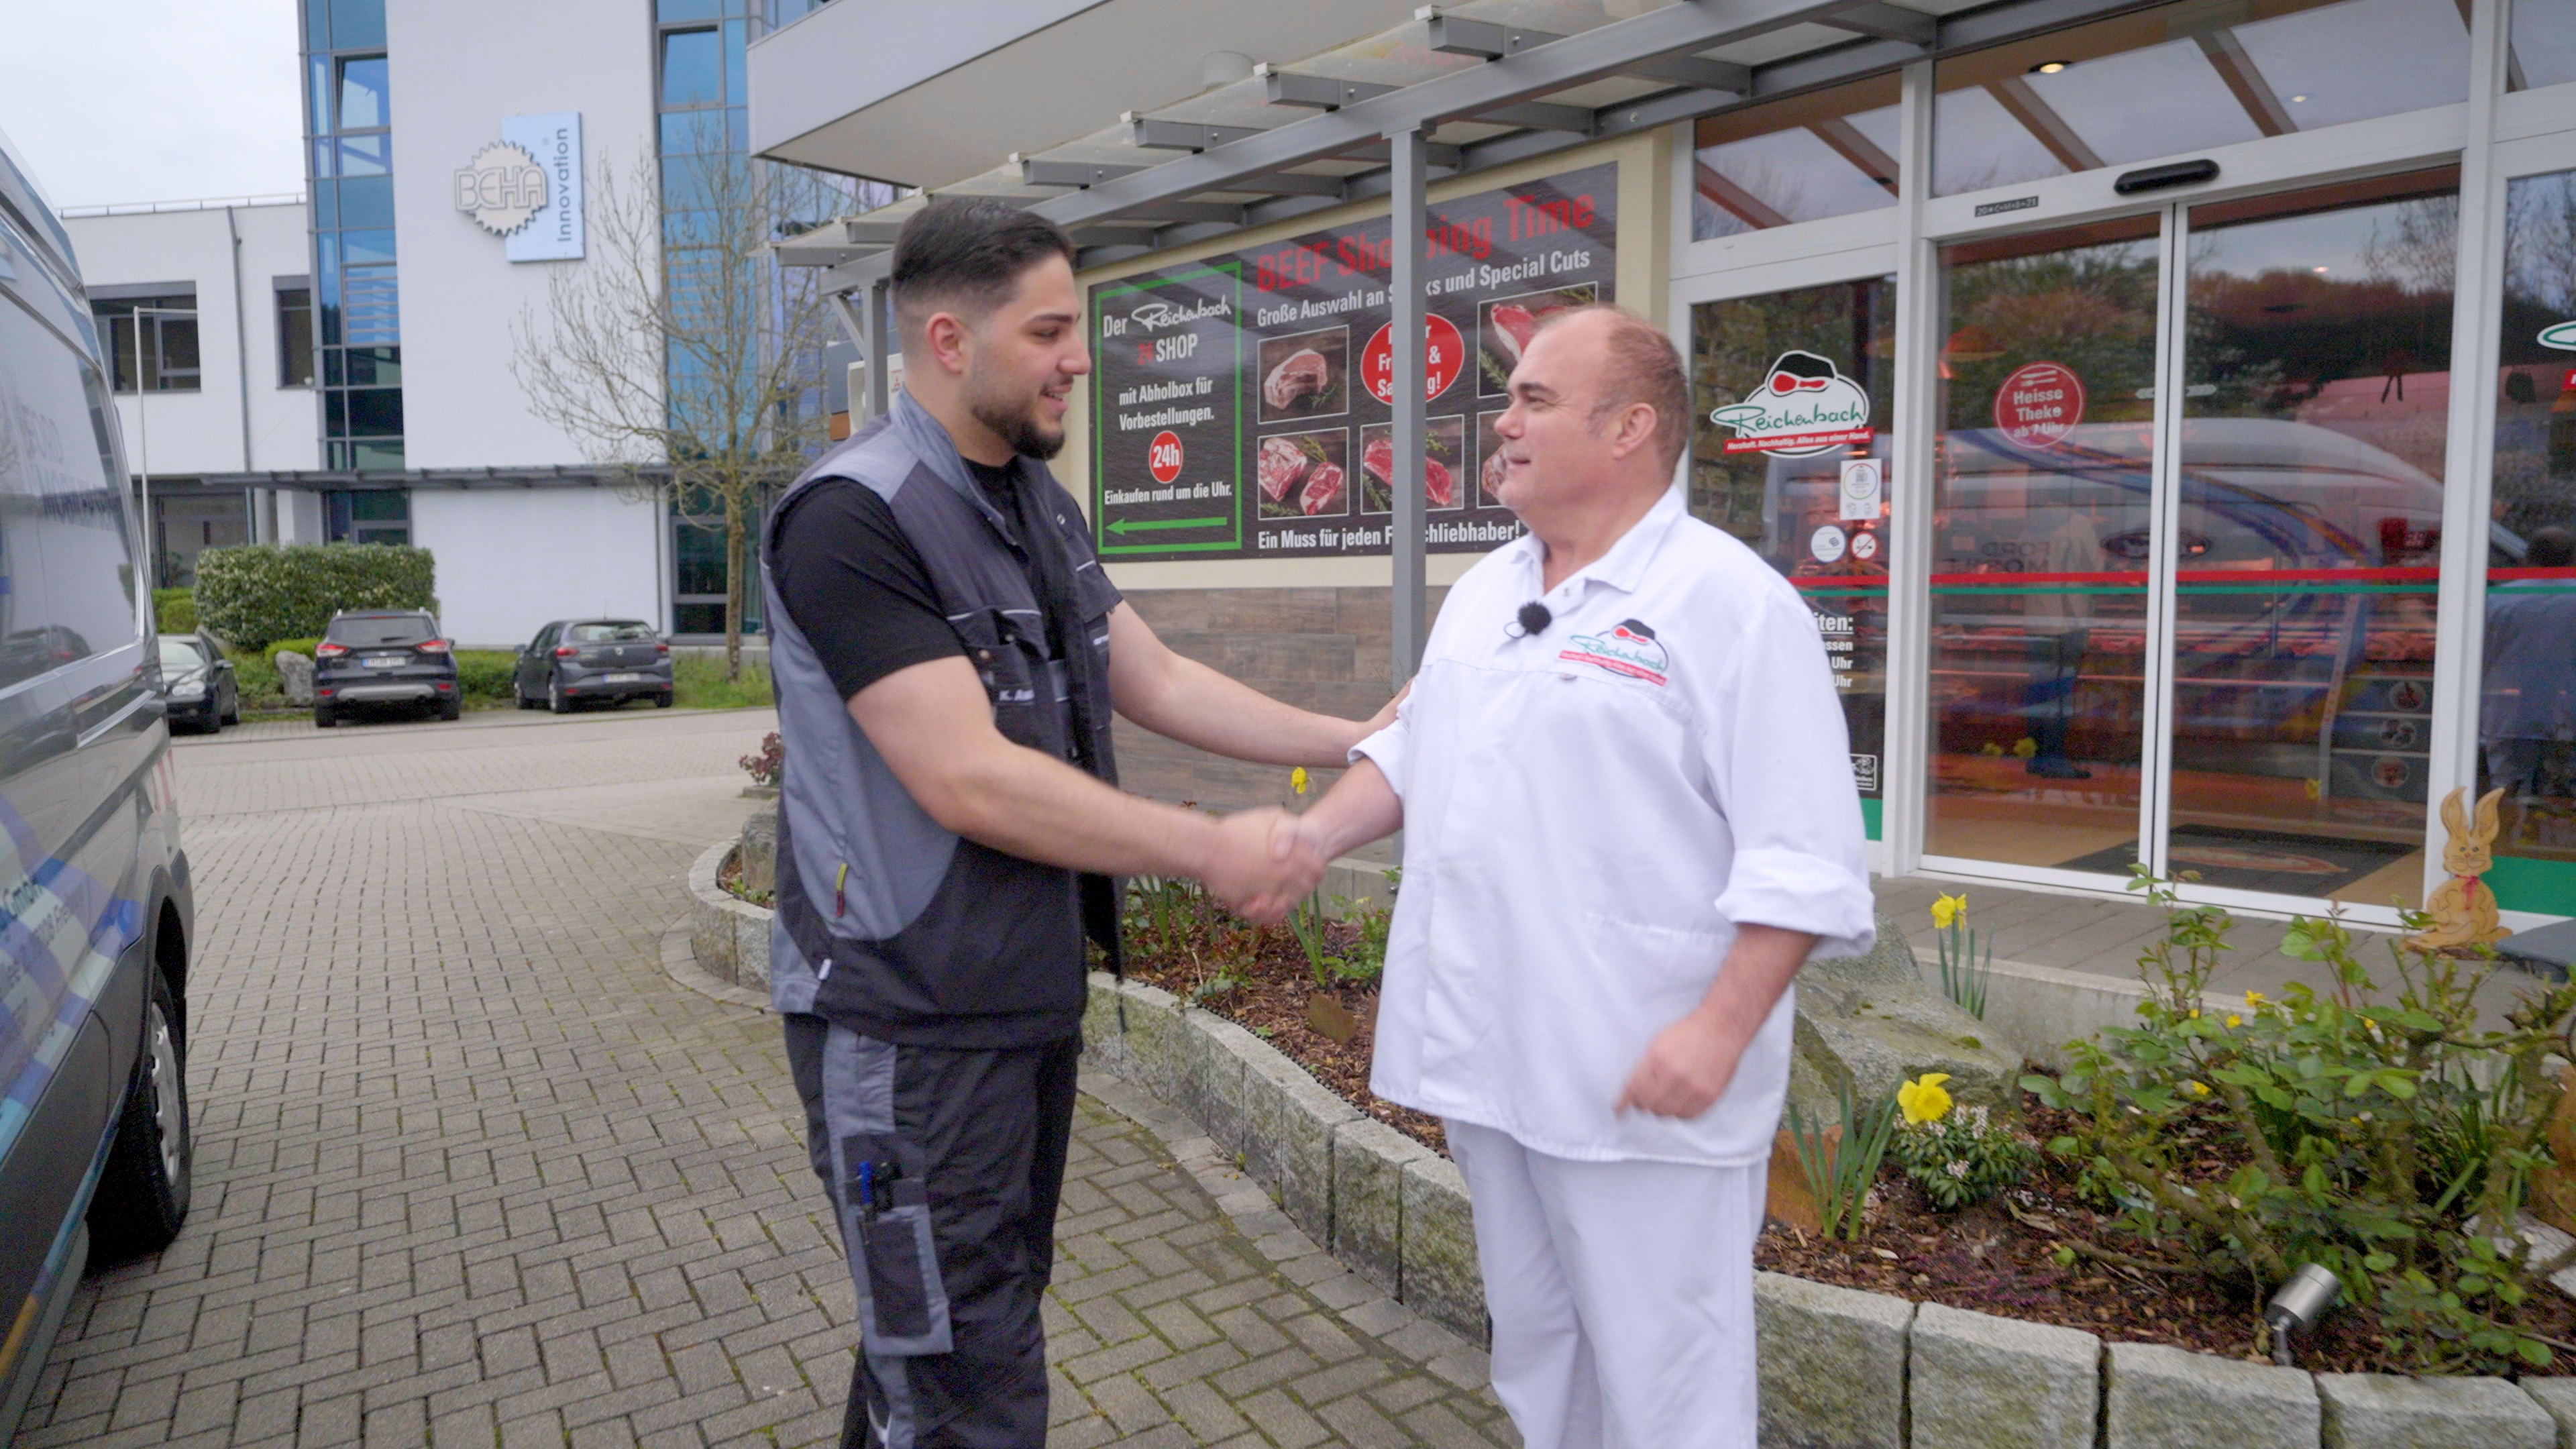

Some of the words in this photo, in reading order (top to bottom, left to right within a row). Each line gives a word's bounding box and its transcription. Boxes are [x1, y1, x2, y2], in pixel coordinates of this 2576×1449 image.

[455, 165, 548, 211] BEHA
[553, 128, 572, 241] Innovation
[1257, 241, 1329, 293] BEEF
[1338, 215, 1492, 276] Shoing
[1503, 194, 1595, 241] Time
[1257, 304, 1297, 327] Große
[1300, 289, 1362, 319] Auswahl
[1366, 290, 1384, 307] an
[1445, 268, 1474, 292] und
[1480, 254, 1545, 290] Special
[1550, 250, 1590, 273] Cuts
[1104, 315, 1127, 337] Der
[1131, 295, 1232, 332] Reichenbach
[1156, 333, 1198, 362] SHOP
[1428, 345, 1441, 364] &
[1119, 387, 1137, 406] mit
[1138, 381, 1193, 402] Abholbox
[1195, 376, 1213, 394] für
[2013, 388, 2063, 405] Heisse
[1119, 407, 1214, 431] Vorbestellungen.
[1713, 401, 1863, 435] Reichenbach
[2016, 405, 2061, 421] Theke
[2013, 425, 2029, 438] ab
[2032, 424, 2040, 435] 7
[2041, 421, 2064, 435] Uhr
[1153, 443, 1180, 468] 24h
[1104, 488, 1150, 505] Einkaufen
[1152, 485, 1173, 501] rund
[1176, 488, 1191, 500] um
[1193, 482, 1210, 498] die
[1211, 481, 1232, 497] Uhr.
[1258, 531, 1278, 549] Ein
[1281, 530, 1316, 548] Muss
[1319, 528, 1338, 547] für
[1342, 527, 1381, 550] jeden
[1831, 656, 1853, 669] Uhr
